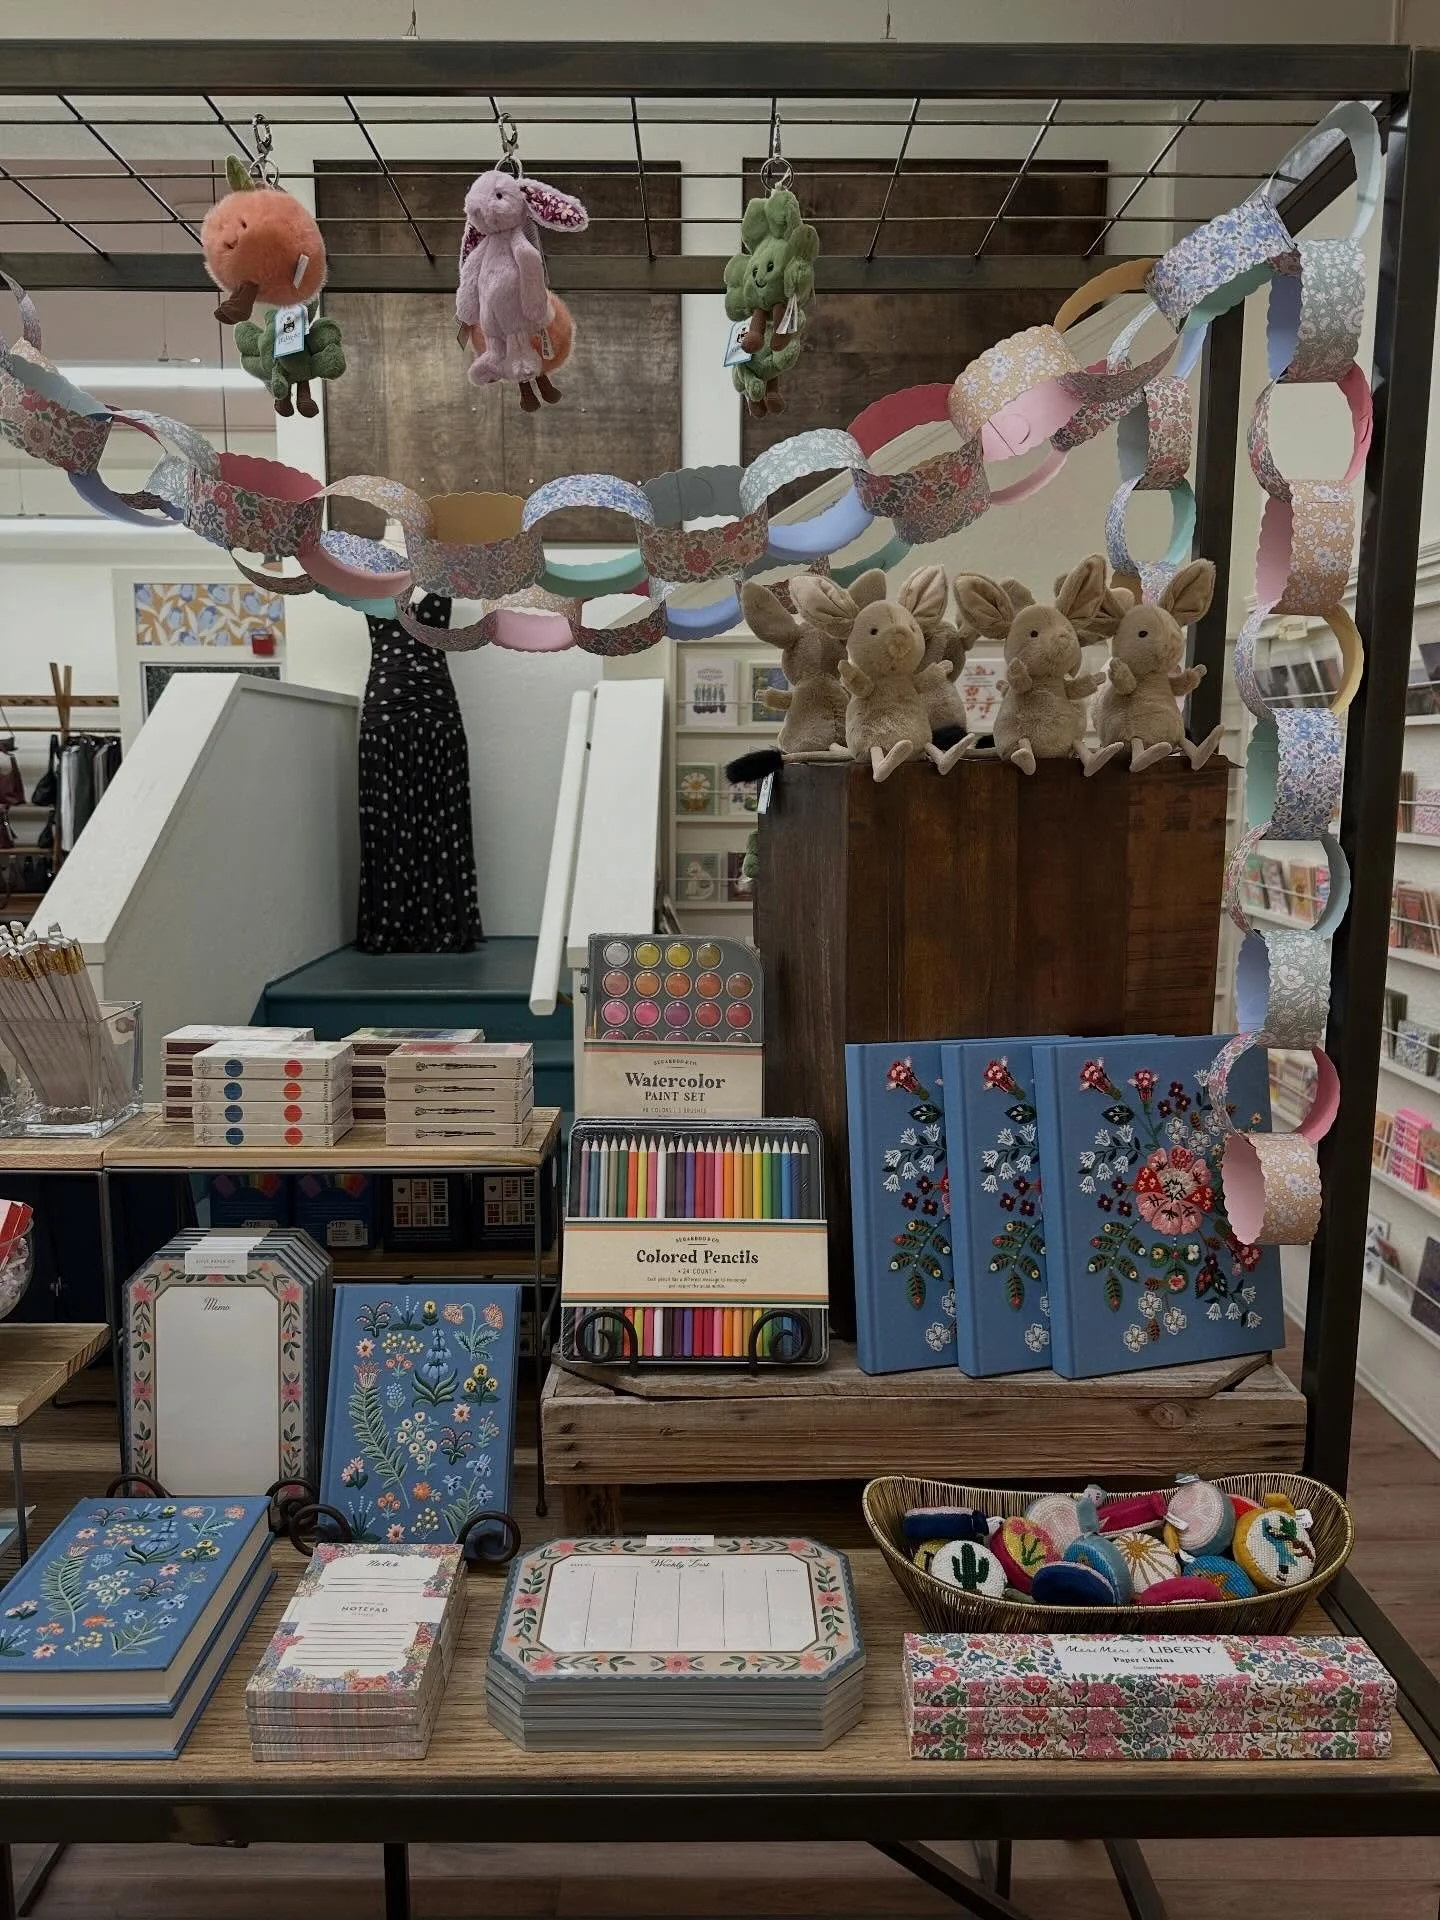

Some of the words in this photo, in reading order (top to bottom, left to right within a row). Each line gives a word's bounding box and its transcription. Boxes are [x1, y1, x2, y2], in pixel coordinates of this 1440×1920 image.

[625, 1072, 726, 1089] Watercolor
[645, 1091, 678, 1101] PAINT
[683, 1092, 706, 1102] SET
[636, 1249, 698, 1264] Colored
[703, 1250, 760, 1265] Pencils
[202, 1297, 231, 1312] Memo
[365, 1559, 400, 1568] Notes
[651, 1558, 686, 1569] Weekly
[688, 1558, 711, 1568] List
[1113, 1656, 1139, 1664] Paper
[1142, 1656, 1175, 1664] Chains
